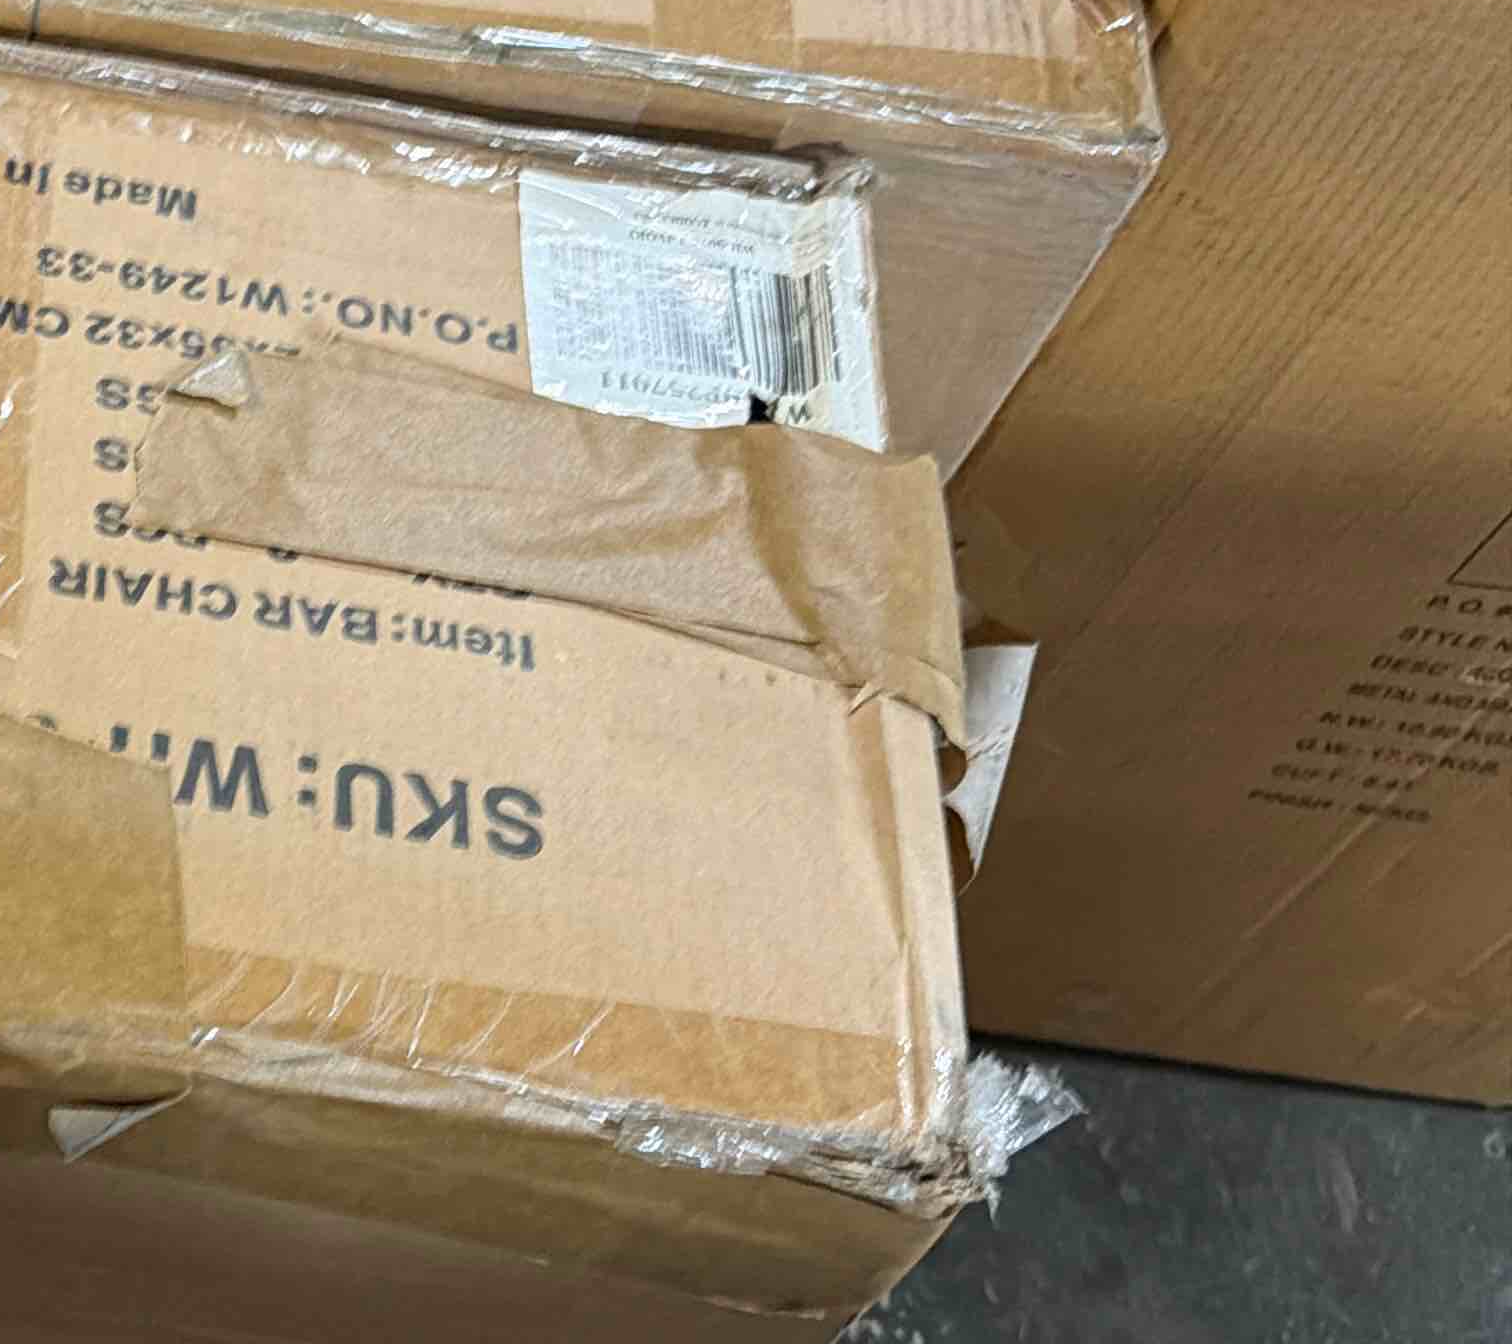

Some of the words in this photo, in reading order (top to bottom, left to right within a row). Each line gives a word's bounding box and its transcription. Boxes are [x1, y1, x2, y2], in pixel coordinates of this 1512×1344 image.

[63, 167, 199, 222] Made
[36, 245, 290, 317] W1249-33
[48, 556, 239, 622] CHAIR
[253, 591, 379, 647] BAR
[391, 613, 537, 673] Item:
[297, 753, 546, 861] SKU:
